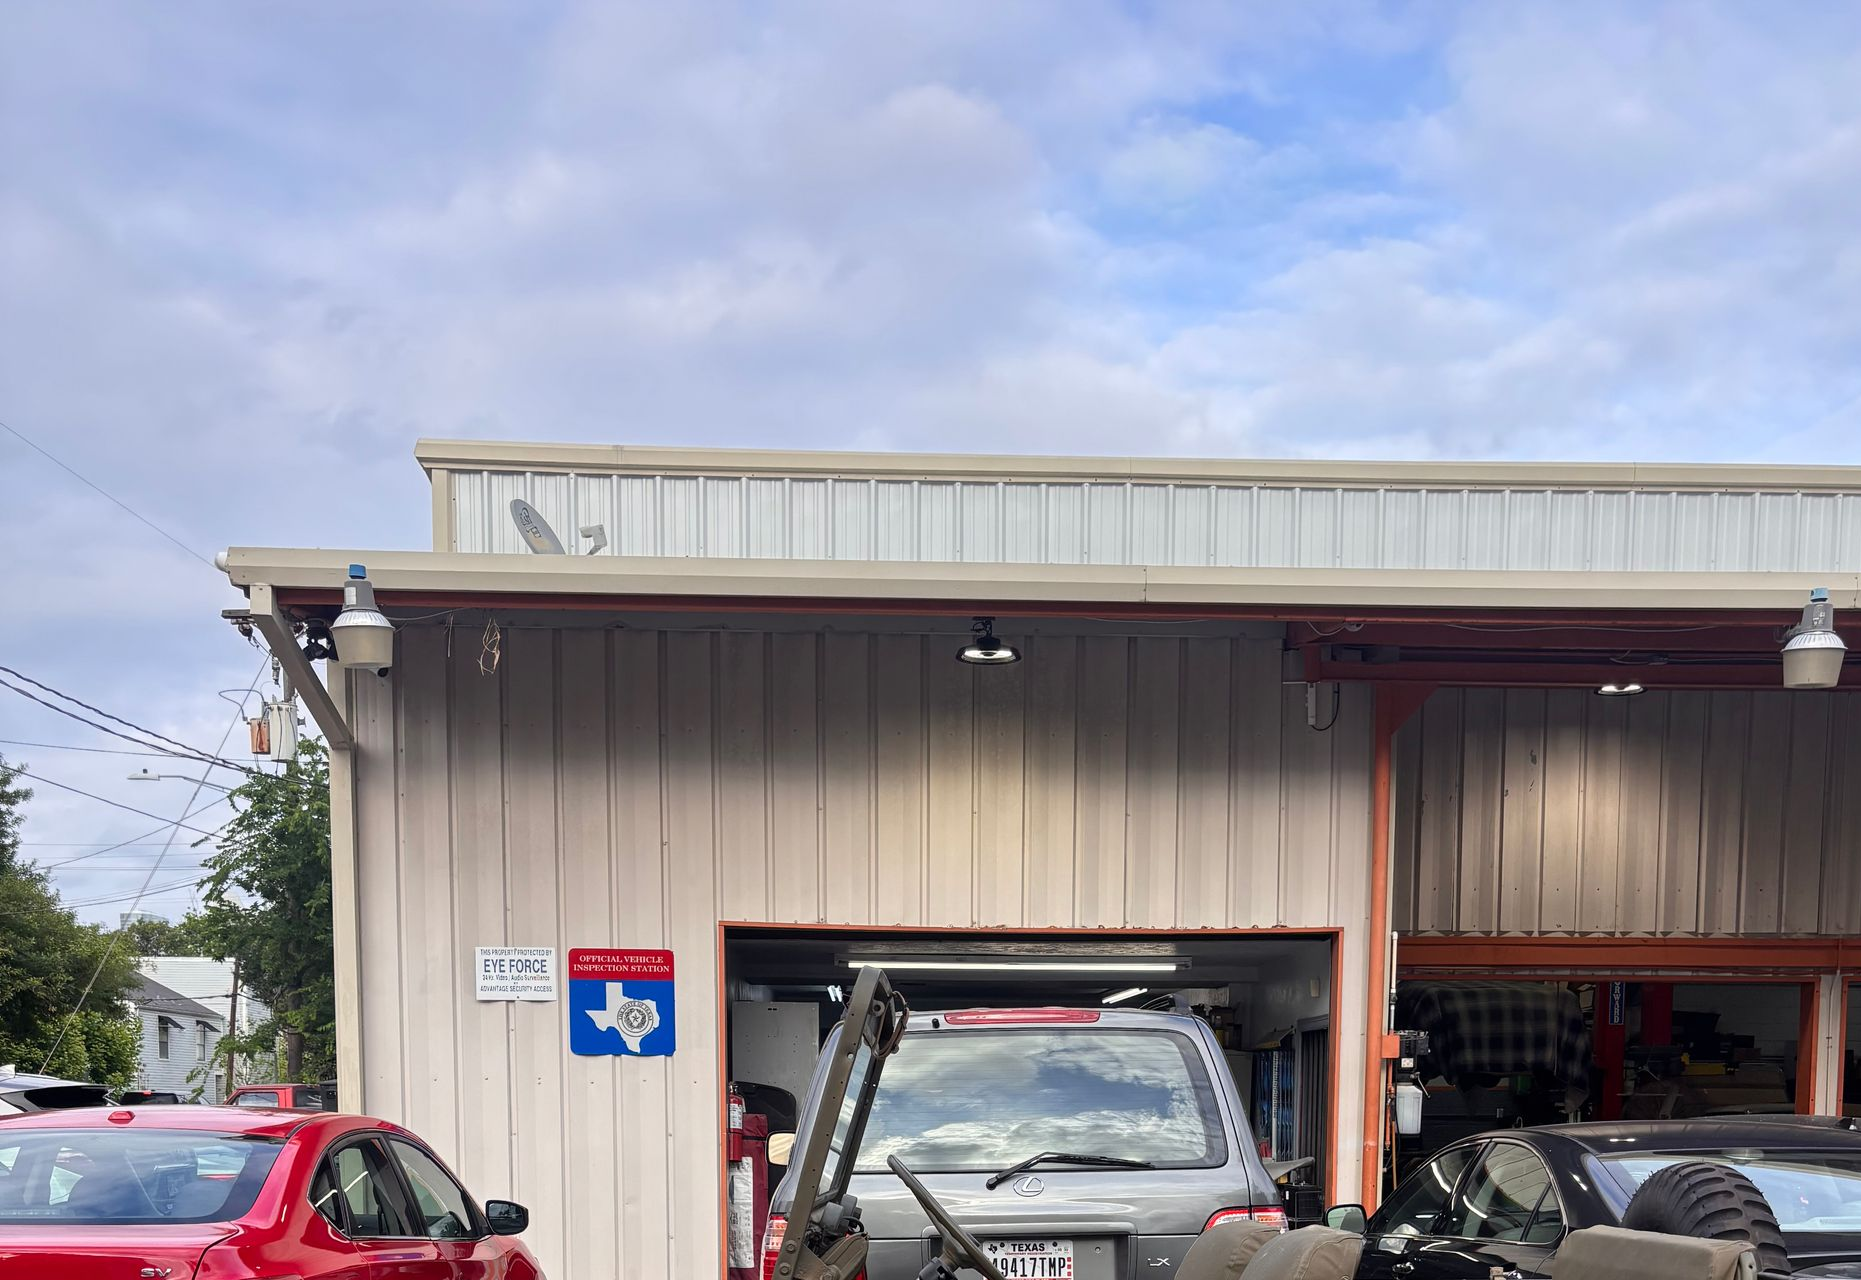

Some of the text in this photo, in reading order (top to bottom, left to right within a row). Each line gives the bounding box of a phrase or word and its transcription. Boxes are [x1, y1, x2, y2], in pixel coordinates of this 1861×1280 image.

[492, 948, 517, 956] PROPERTY
[579, 954, 664, 964] OFFICIAL VEHICLE
[483, 958, 548, 973] EYE FORCE
[573, 964, 629, 972] INSPECTION
[1010, 1243, 1046, 1252] TEXAS
[1147, 1257, 1171, 1267] LX
[140, 1267, 172, 1278] SV
